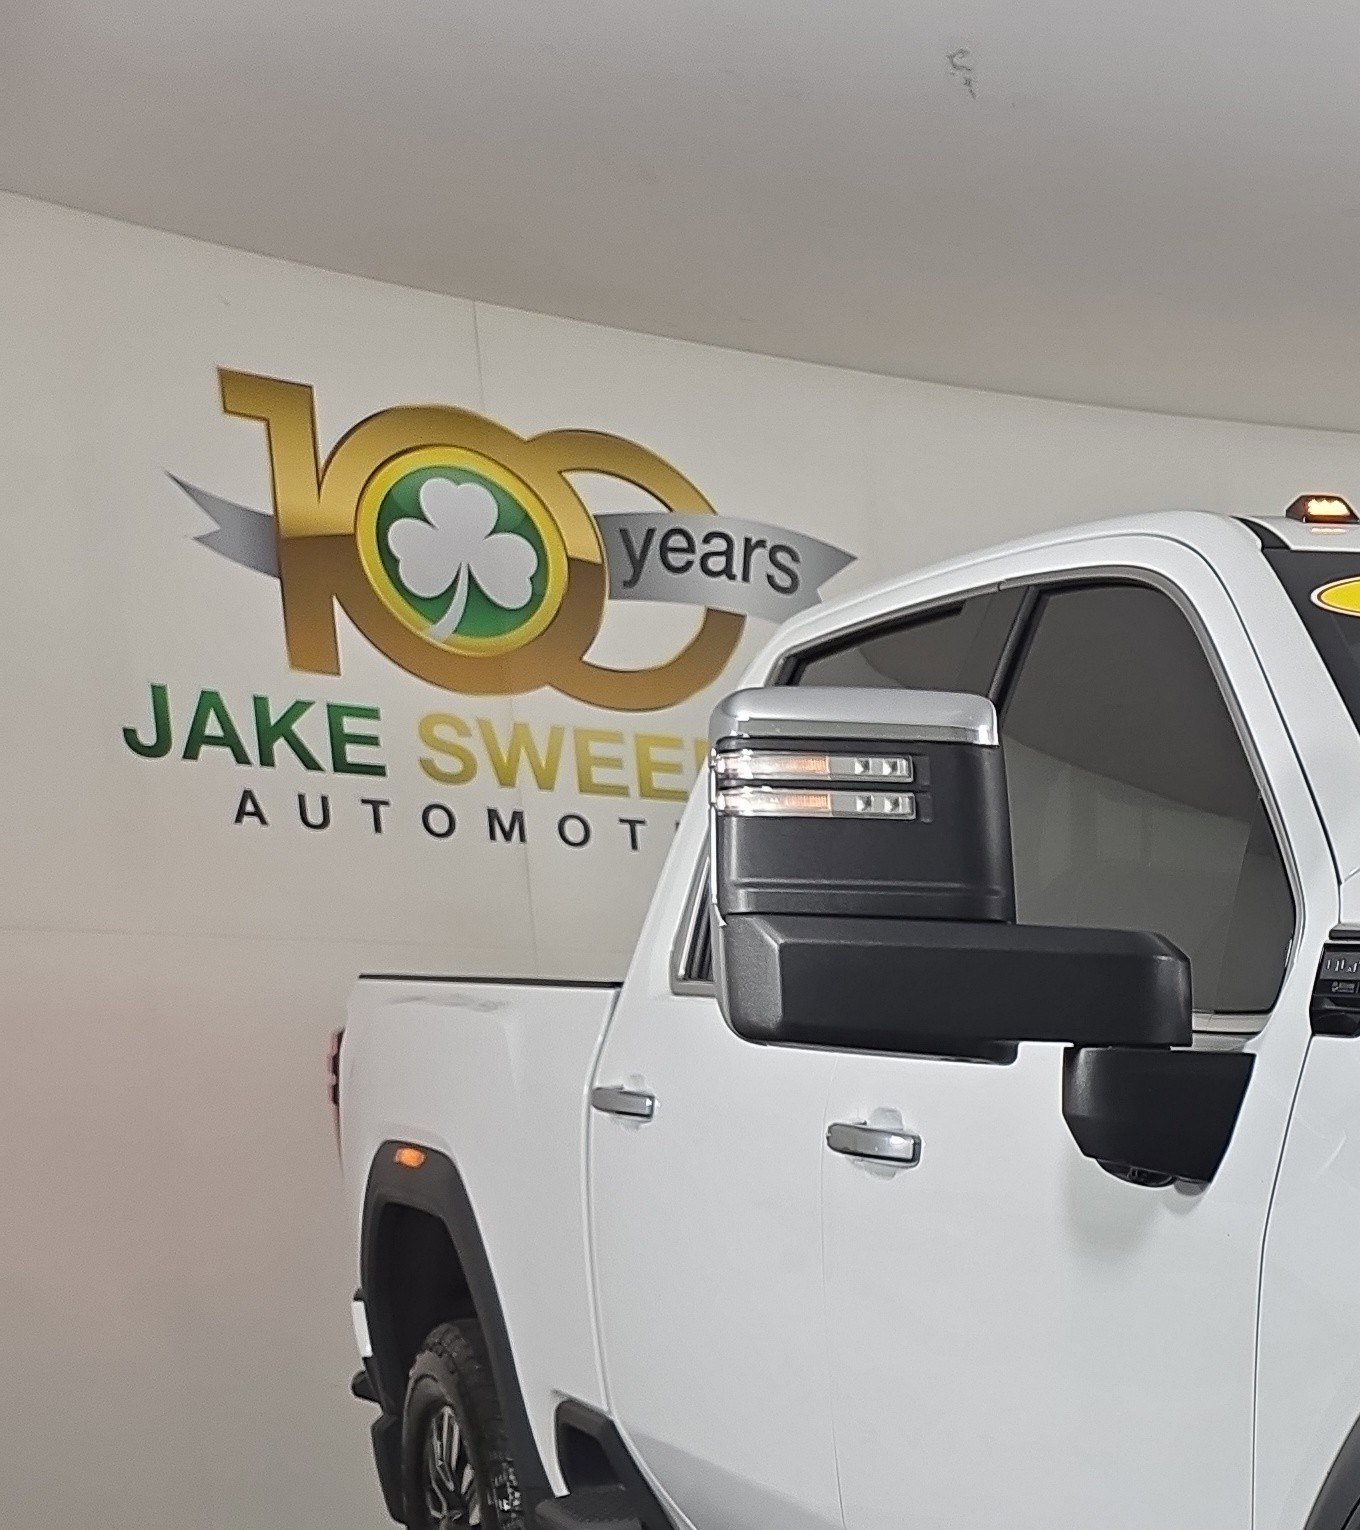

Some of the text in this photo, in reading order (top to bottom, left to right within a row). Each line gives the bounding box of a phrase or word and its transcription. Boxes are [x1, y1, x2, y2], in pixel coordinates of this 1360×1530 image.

[217, 367, 746, 712] 100
[621, 526, 801, 595] years
[122, 682, 709, 803] JAKE SWEE
[234, 789, 680, 851] AUTOMOT
